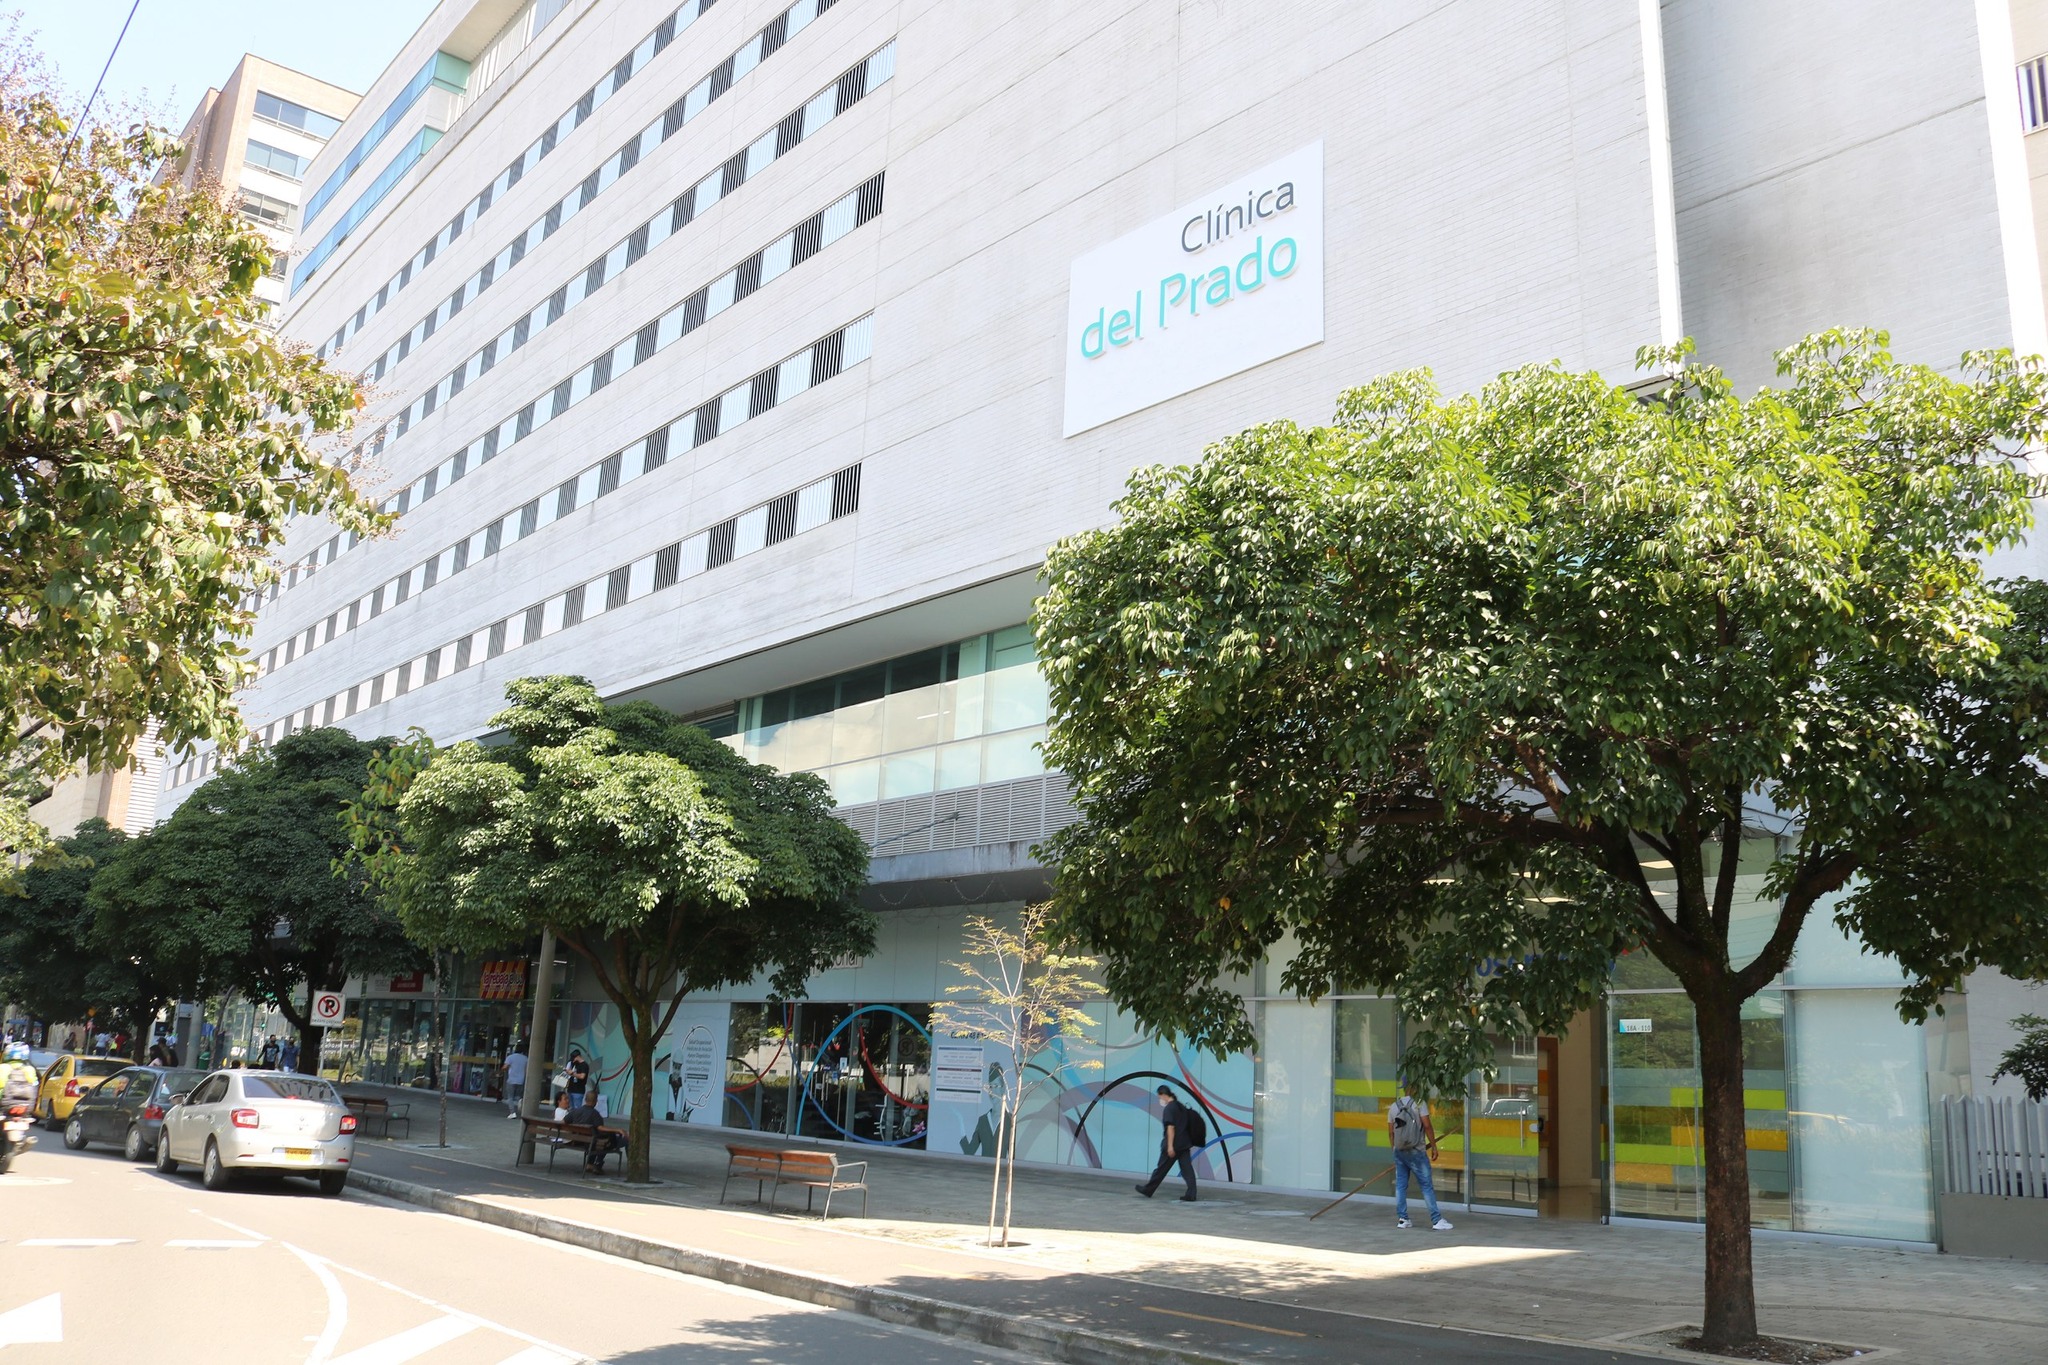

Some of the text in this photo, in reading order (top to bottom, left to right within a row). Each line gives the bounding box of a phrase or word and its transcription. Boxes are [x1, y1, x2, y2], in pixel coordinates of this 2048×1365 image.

[1181, 181, 1295, 253] Clínica
[1081, 236, 1298, 358] del Prado
